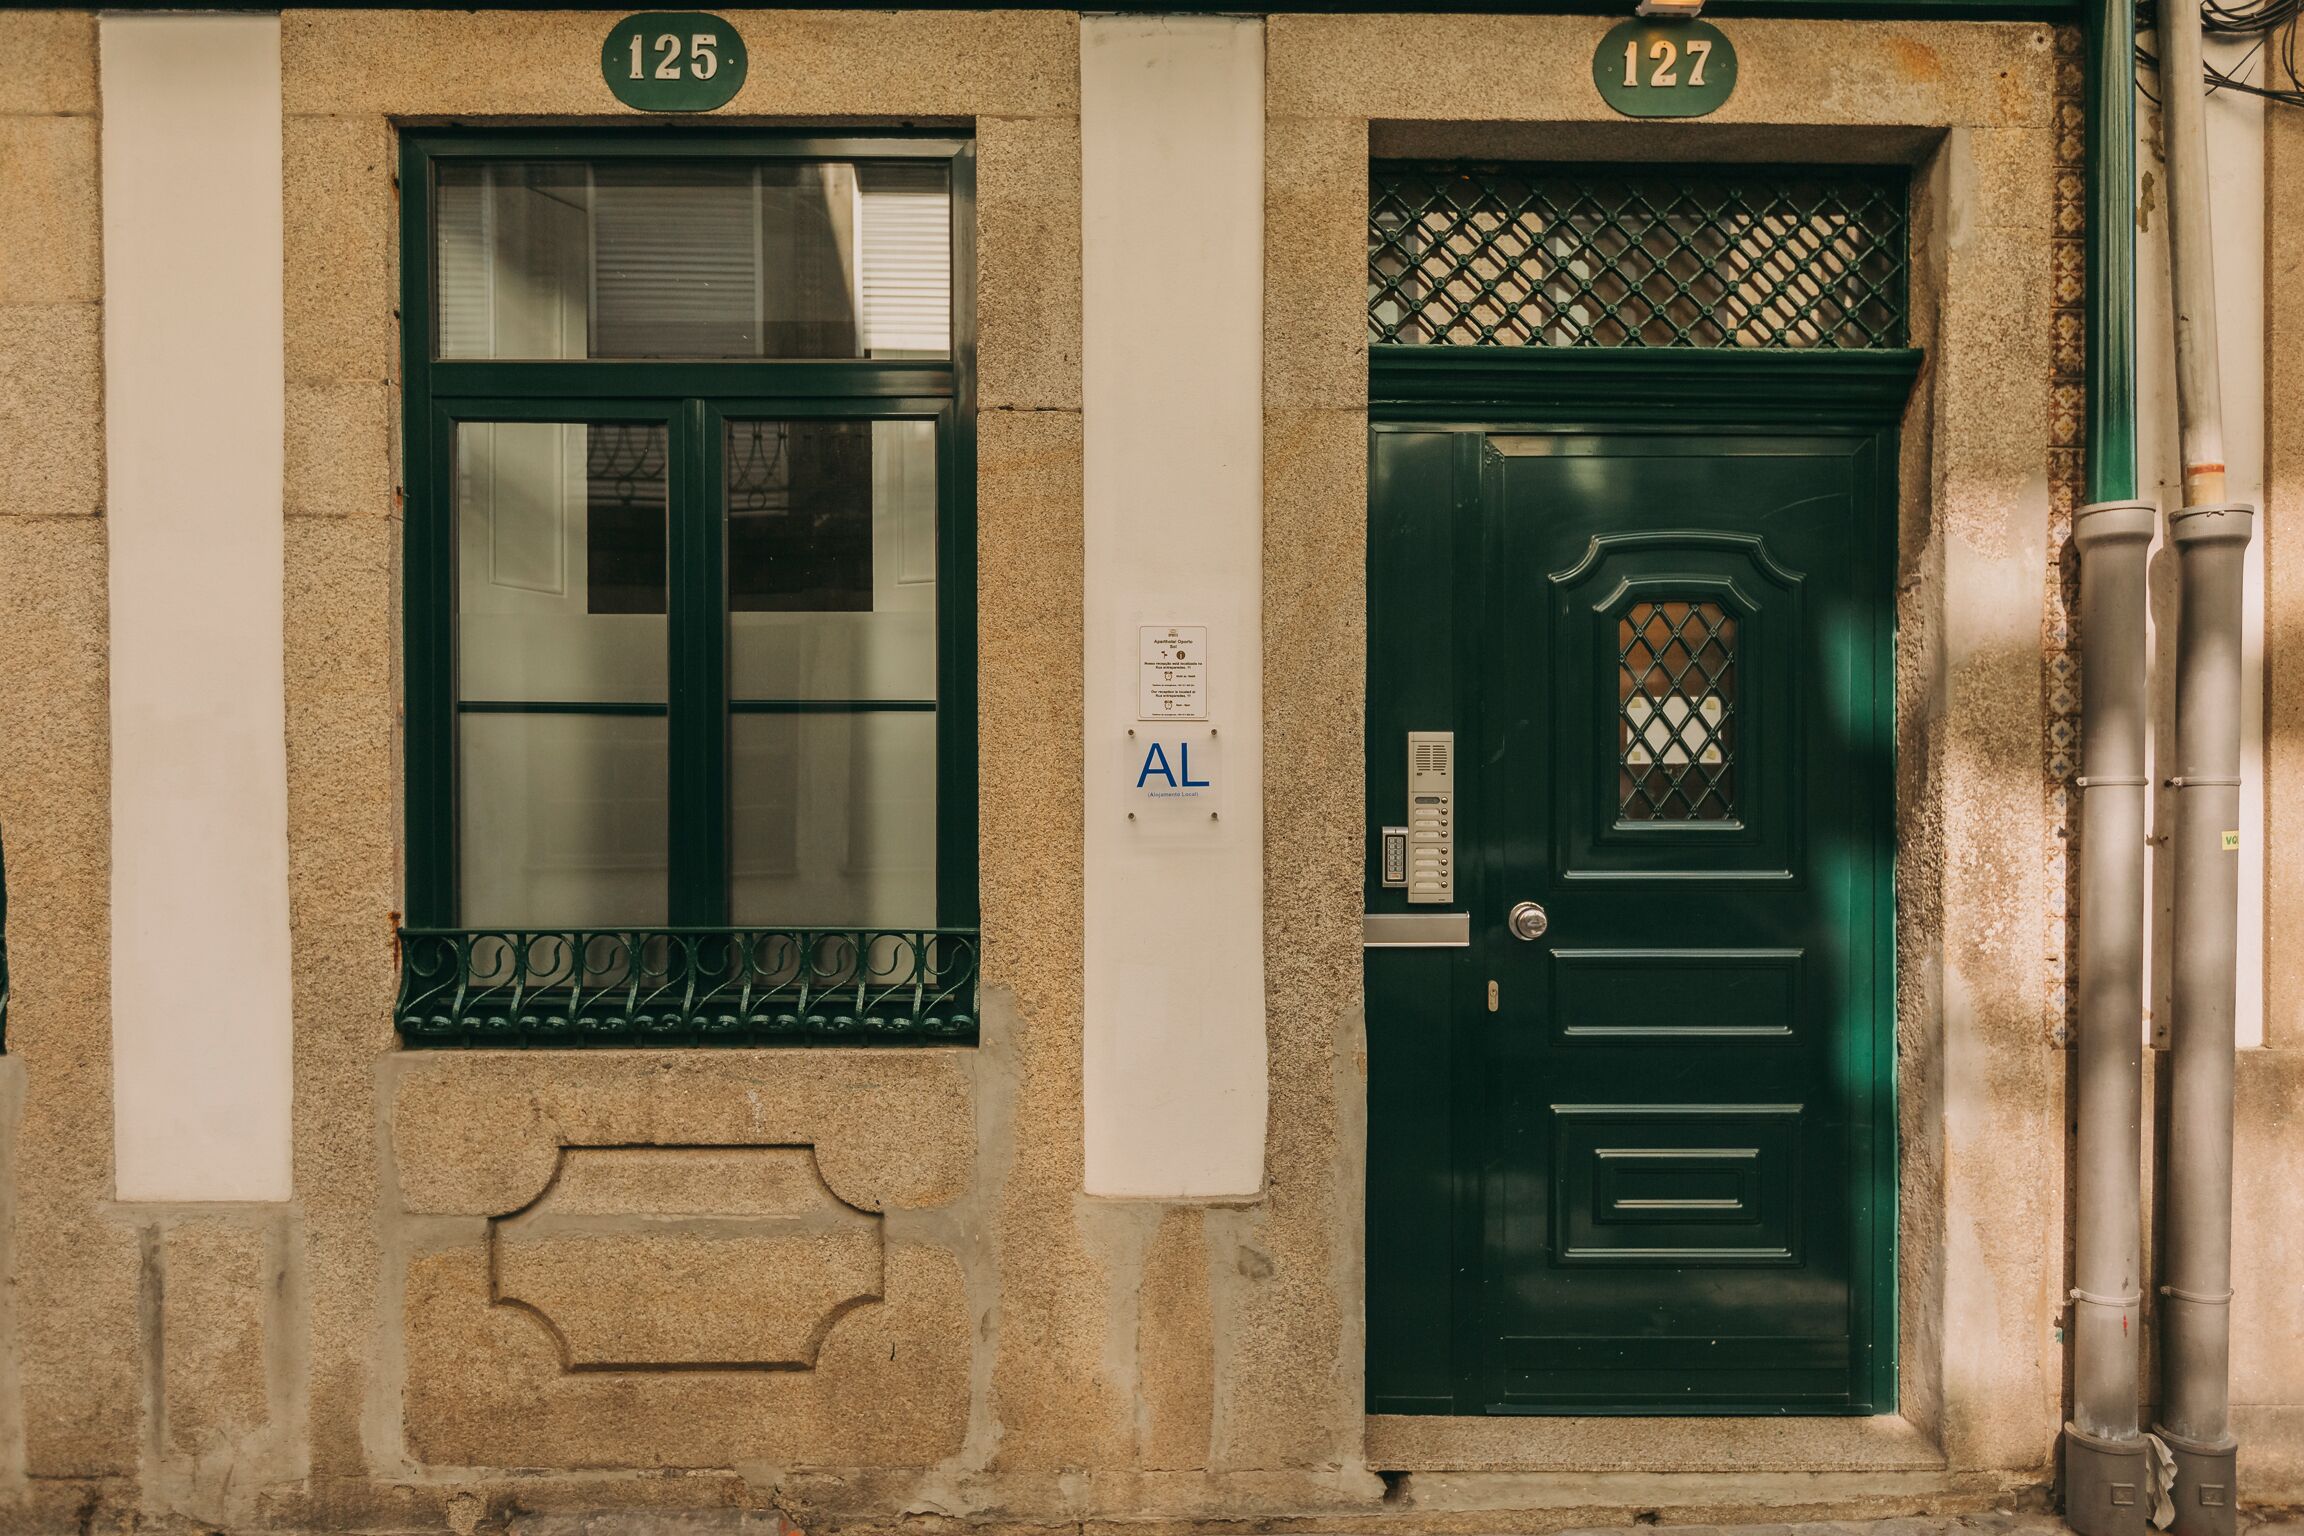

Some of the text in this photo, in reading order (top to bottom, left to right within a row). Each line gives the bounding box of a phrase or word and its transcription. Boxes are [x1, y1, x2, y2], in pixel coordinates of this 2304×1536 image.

[629, 33, 718, 80] 125
[1623, 40, 1712, 87] 127
[1136, 742, 1210, 787] AL
